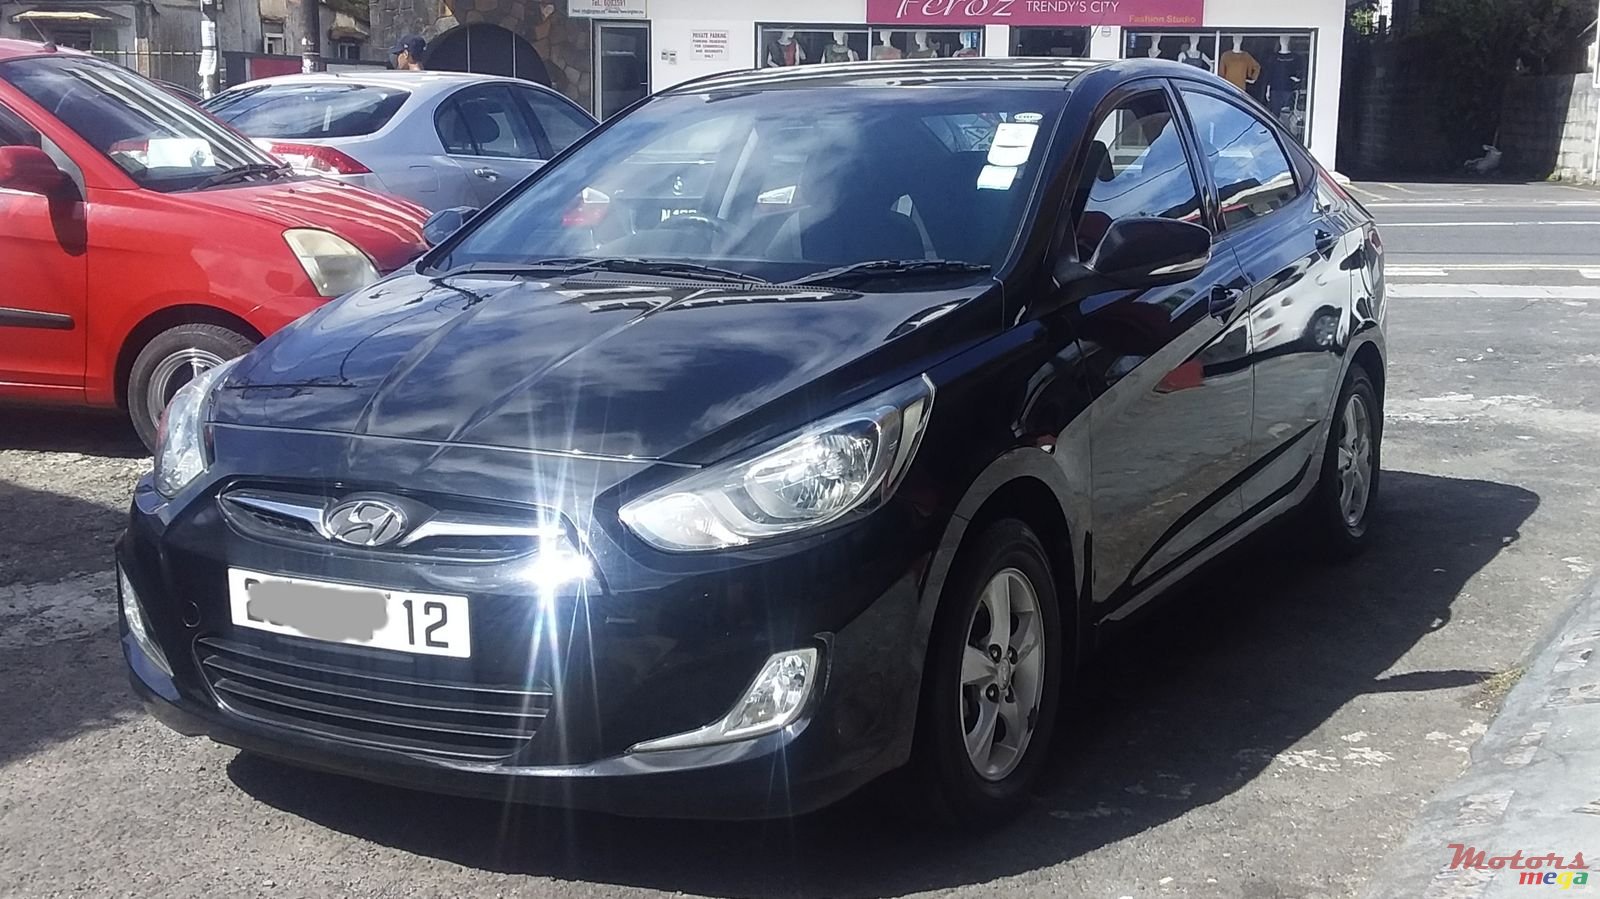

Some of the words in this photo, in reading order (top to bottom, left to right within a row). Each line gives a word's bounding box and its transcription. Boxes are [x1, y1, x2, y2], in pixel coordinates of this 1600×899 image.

[896, 0, 1015, 18] Feroz
[1026, 1, 1087, 13] TRENDY'S
[1090, 1, 1119, 13] CITY
[1129, 15, 1165, 23] Fashion
[1166, 15, 1196, 23] Studio
[402, 599, 449, 648] 12
